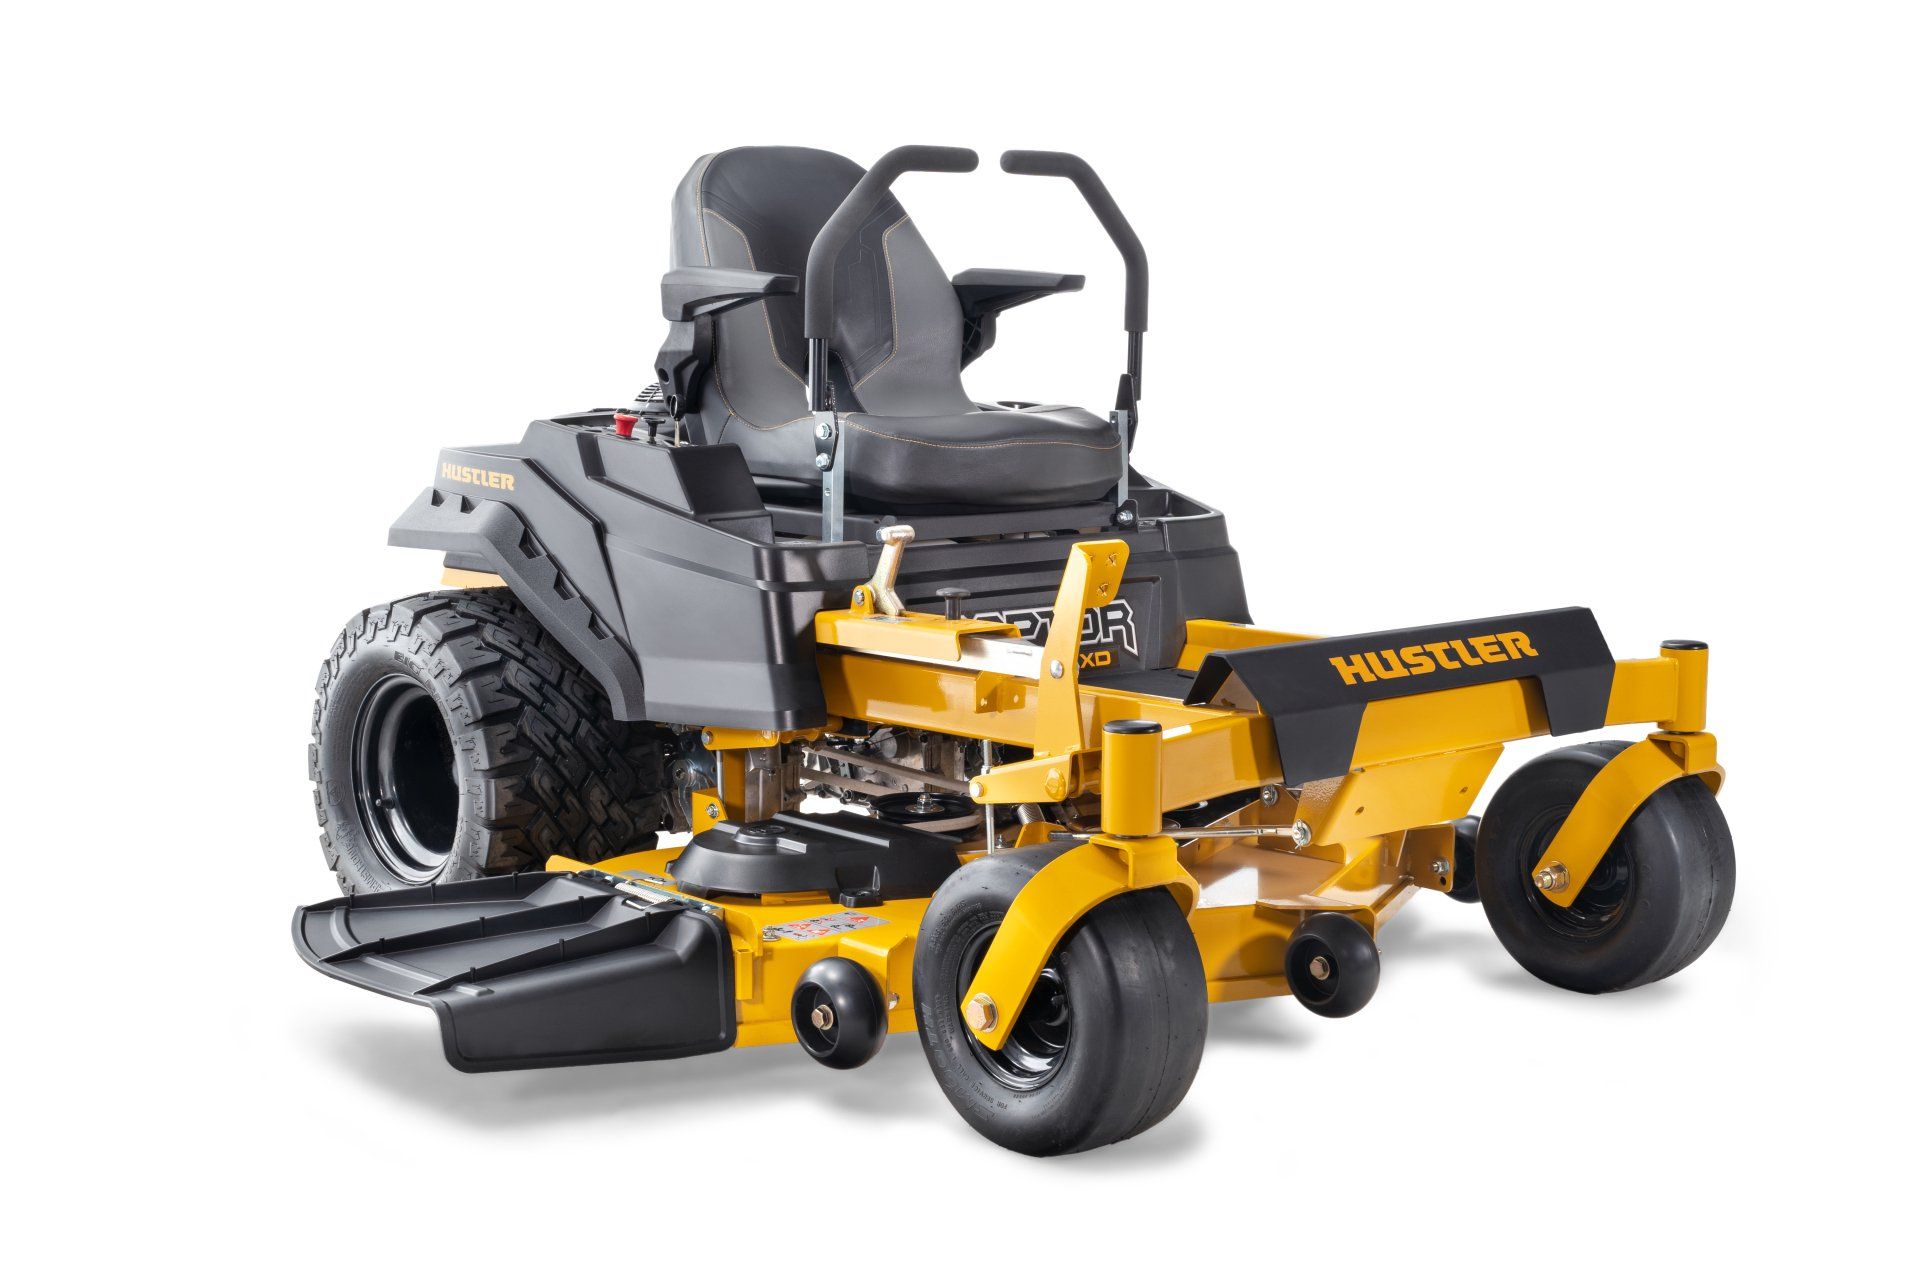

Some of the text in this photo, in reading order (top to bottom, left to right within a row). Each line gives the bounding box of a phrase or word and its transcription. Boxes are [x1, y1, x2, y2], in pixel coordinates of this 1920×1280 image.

[441, 462, 515, 491] HUSTLER
[1080, 650, 1112, 669] XD
[1328, 630, 1539, 686] HUSTLER
